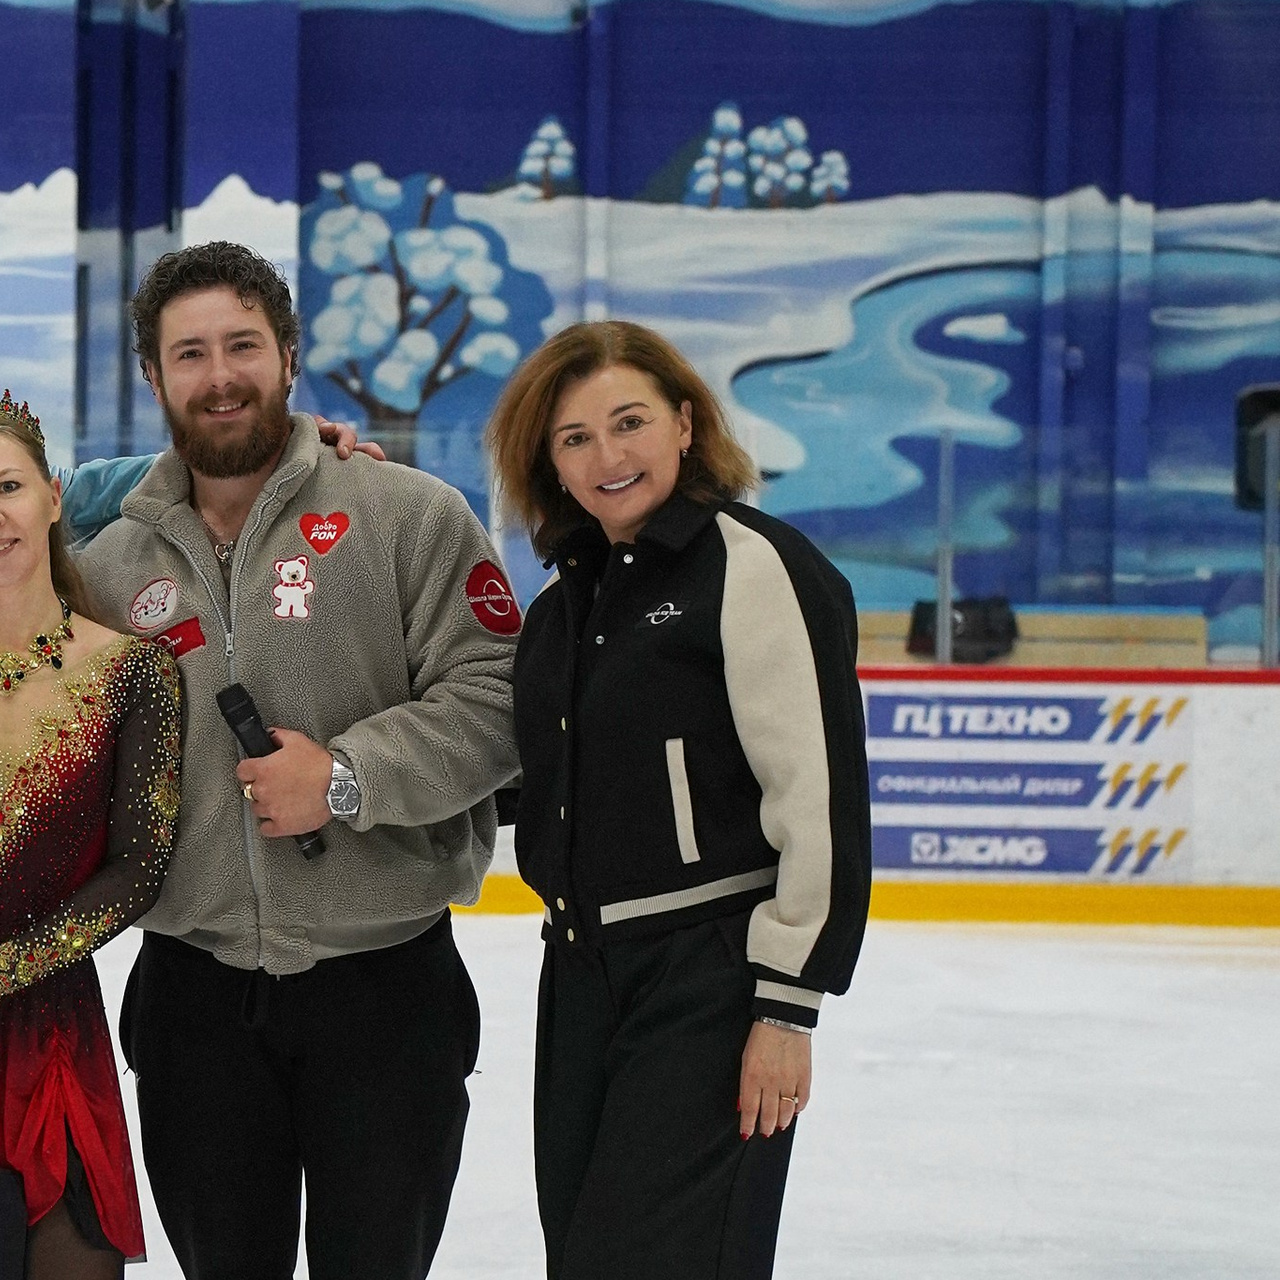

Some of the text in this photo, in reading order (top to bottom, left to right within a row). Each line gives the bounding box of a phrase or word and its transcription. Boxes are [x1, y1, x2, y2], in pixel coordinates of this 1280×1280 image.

[312, 521, 337, 531] Добро
[310, 531, 337, 540] FON
[893, 703, 1071, 737] ГЦ ТЕХНО
